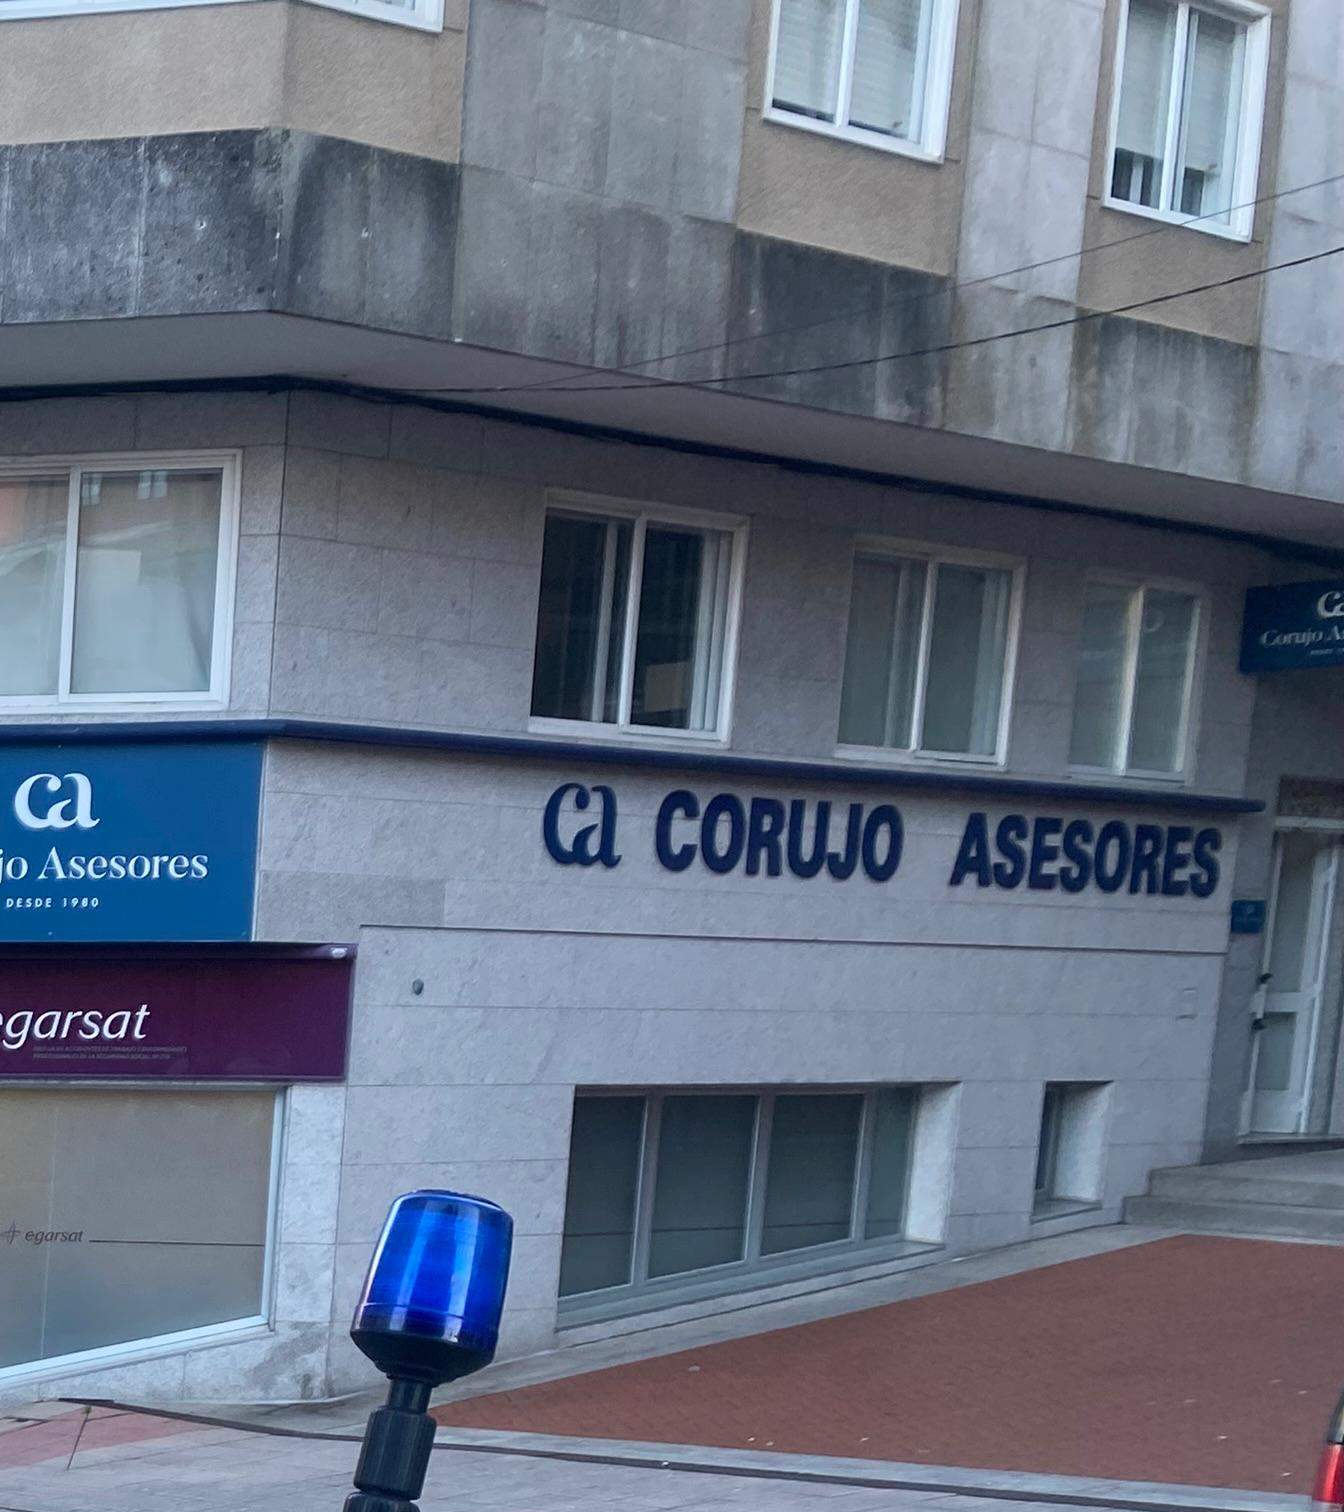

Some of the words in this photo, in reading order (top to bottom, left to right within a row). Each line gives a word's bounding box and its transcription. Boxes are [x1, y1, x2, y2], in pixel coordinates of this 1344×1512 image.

[14, 773, 100, 830] ca
[655, 790, 904, 882] CORUJO
[949, 812, 1223, 898] ASESORES
[39, 846, 209, 881] Asesores
[5, 896, 53, 909] DESDE
[62, 896, 101, 909] 1980
[25, 1230, 83, 1245] egarsat
